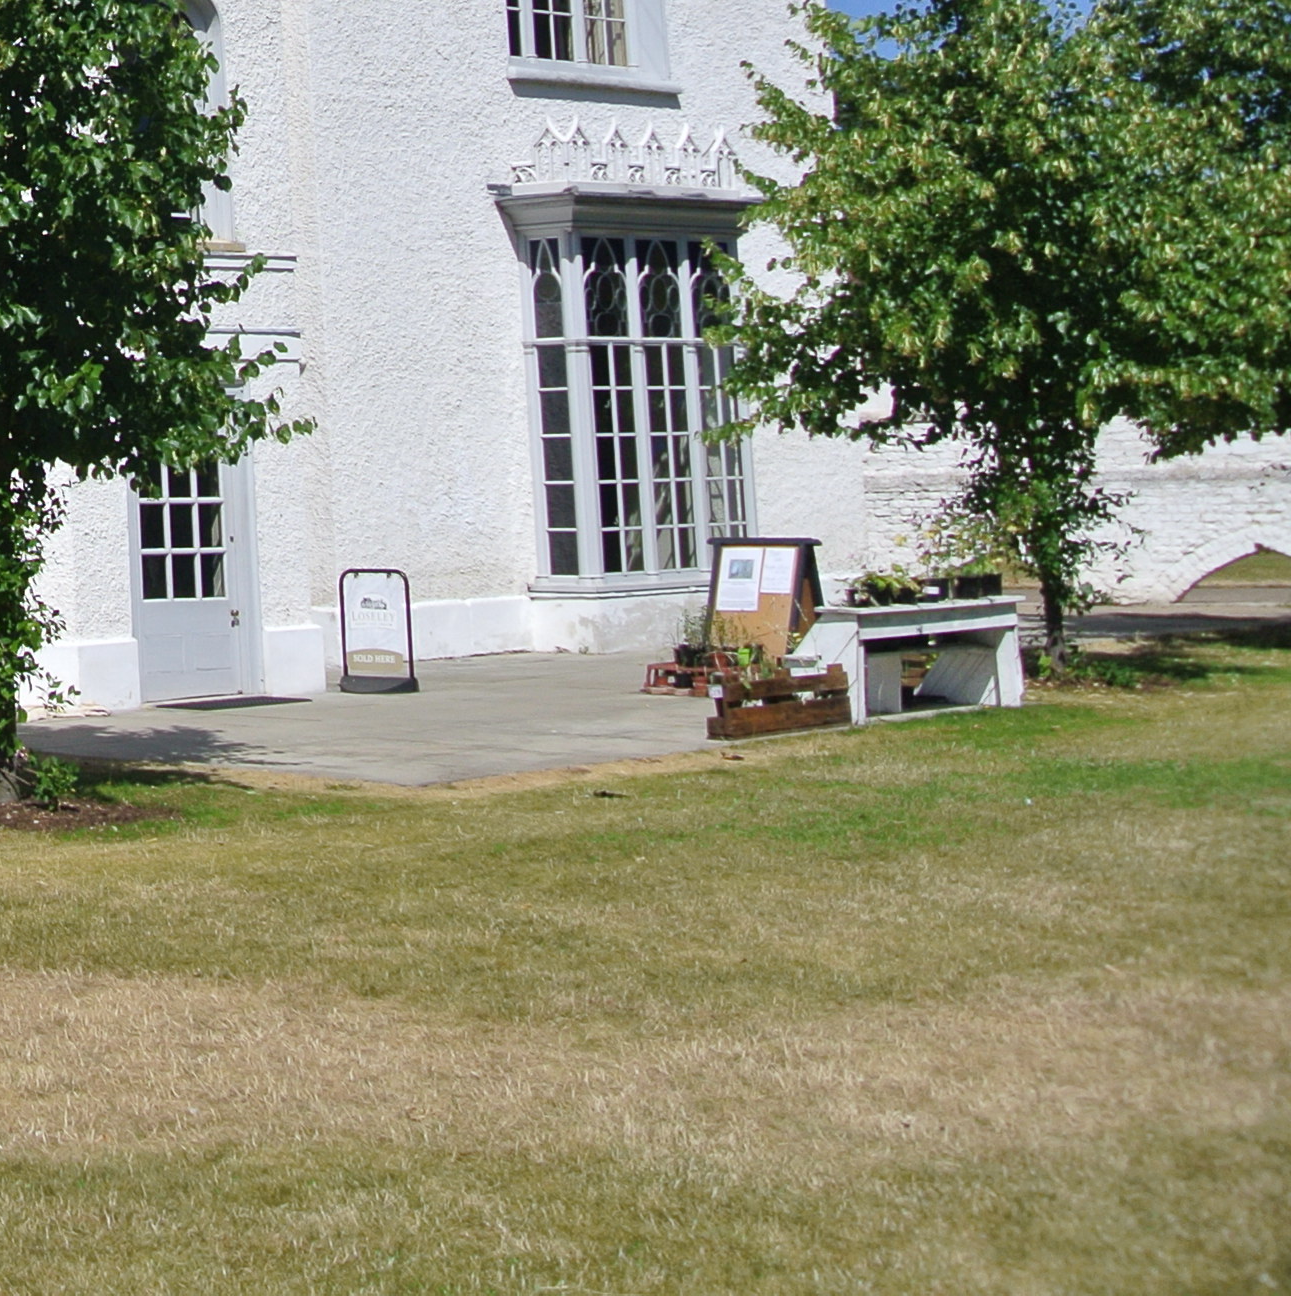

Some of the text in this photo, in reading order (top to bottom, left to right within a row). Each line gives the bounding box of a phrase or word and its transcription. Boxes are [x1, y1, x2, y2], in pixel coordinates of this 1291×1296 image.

[352, 610, 395, 622] LOSELEY
[353, 654, 395, 664] SOLD HERE
